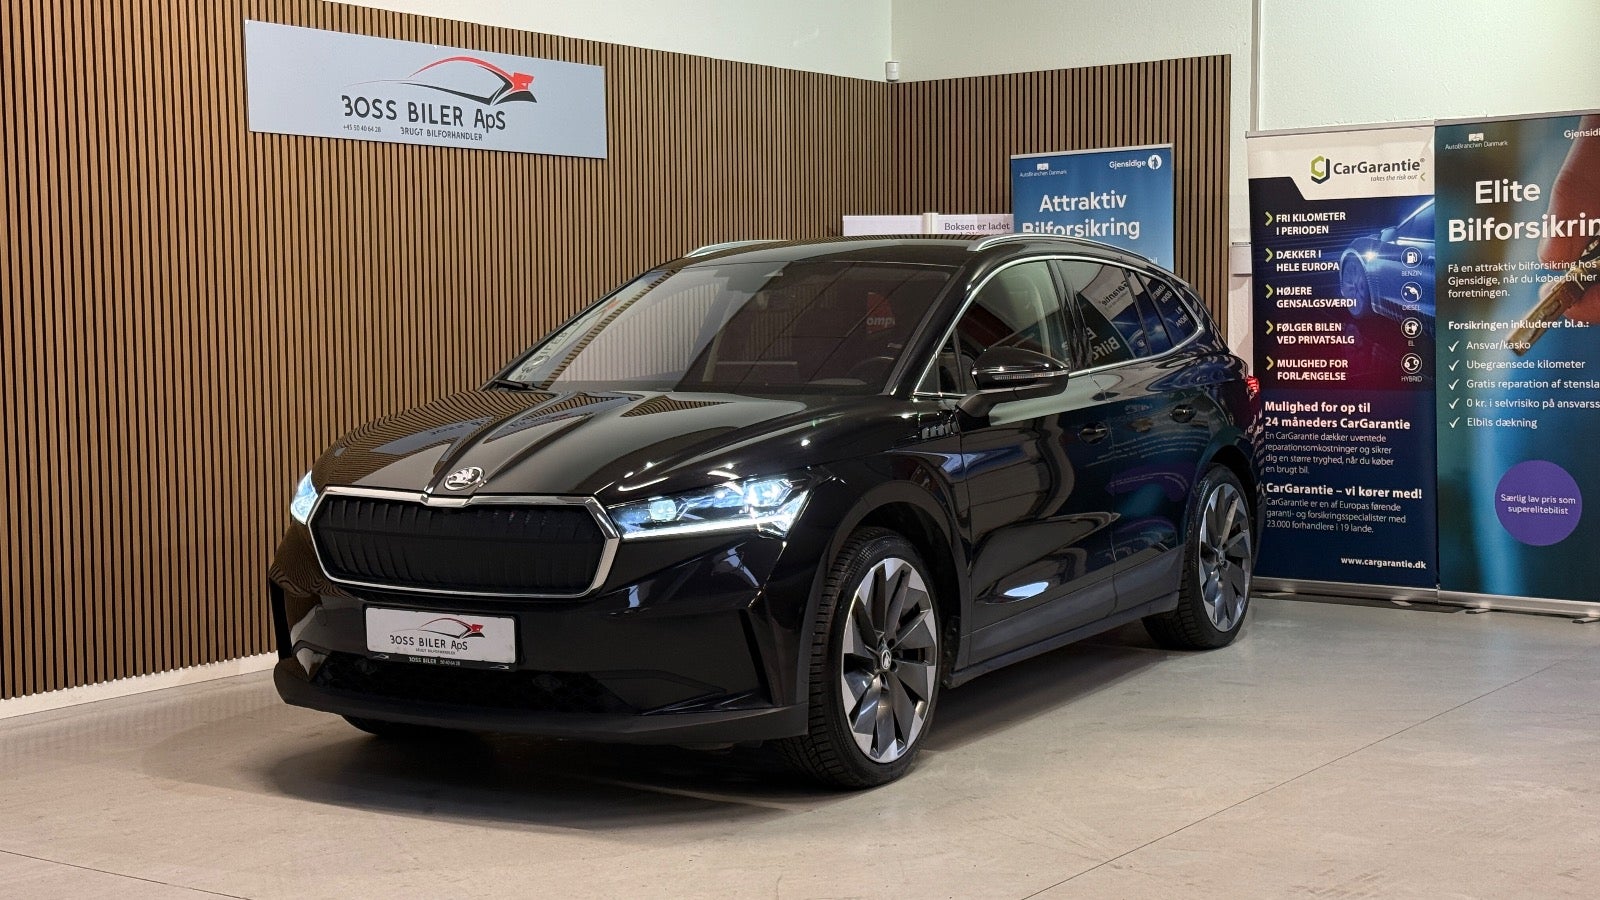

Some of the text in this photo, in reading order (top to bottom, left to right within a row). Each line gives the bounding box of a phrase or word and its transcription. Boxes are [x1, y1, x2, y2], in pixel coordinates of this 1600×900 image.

[408, 102, 464, 127] BILER
[474, 108, 506, 133] ApS
[426, 129, 482, 141] BILFORHANDLER
[1444, 141, 1482, 150] AutoBranchen
[1109, 160, 1146, 170] Gjensidige
[1475, 178, 1541, 204] Elite
[1039, 190, 1127, 213] Attraktiv
[1276, 212, 1346, 223] FRI KILOMETER
[944, 222, 975, 230] Boksen
[1022, 218, 1140, 240] Bilforsikring
[1276, 225, 1329, 235] I PERIODEN
[1276, 250, 1321, 260] DÆKKER I
[1276, 261, 1340, 272] HELE EUROPA
[1448, 264, 1459, 273] Få
[1475, 262, 1516, 272] attraktiv
[1518, 260, 1576, 271] bilforsikring
[1578, 260, 1597, 269] hos
[1448, 272, 1597, 288] Gjensidige, når du køber bil her
[1276, 286, 1312, 296] HØJERE
[1448, 288, 1511, 300] forretningen.
[1276, 298, 1357, 308] GENSALGSVÆRDI
[1276, 322, 1342, 333] FØLGER BILEN
[1448, 319, 1589, 331] Forsikringen inkluderer bl.a.:
[1277, 335, 1355, 345] VED PRIVATSALG
[1466, 341, 1531, 350] Ansvar/kasko
[1277, 359, 1348, 368] MULIGHED FOR
[1466, 360, 1585, 371] Ubegrænsede kilometer
[1277, 372, 1346, 381] FORLÆNGELSE
[1466, 379, 1600, 390] Gratis reparation af stensla
[1265, 401, 1370, 415] Mulighed for op til
[1466, 399, 1473, 408] 0
[1475, 399, 1486, 408] kr.
[1489, 399, 1492, 408] i
[1494, 398, 1540, 408] selvrisiko
[1542, 398, 1555, 410] på
[1265, 416, 1411, 429] 24 måneders CarGarantie
[1467, 418, 1538, 430] Elbils dækning
[1276, 432, 1319, 440] CarGarantie
[1320, 433, 1348, 441] dækker
[1350, 434, 1386, 442] uventede
[1265, 444, 1392, 455] reparationsomkostninger og sikrer
[1265, 454, 1277, 463] dig
[1313, 456, 1344, 465] tryghed,
[1346, 456, 1358, 464] når
[1360, 457, 1370, 465] du
[1372, 457, 1394, 466] køber
[1276, 465, 1298, 475] brugt
[1266, 483, 1333, 495] CarGarantie
[1345, 486, 1356, 496] vi
[1358, 487, 1390, 498] kører
[1392, 488, 1422, 499] med!
[1501, 494, 1526, 504] Særlig
[1541, 495, 1556, 504] pris
[1266, 498, 1309, 508] CarGarantie
[1339, 501, 1370, 511] Europas
[1371, 502, 1401, 512] førende
[1508, 506, 1568, 514] superelitebilist
[1266, 509, 1406, 523] garanti- og forsikringsspecialister med
[1266, 520, 1290, 528] 23.000
[1292, 521, 1334, 531] forhandlere
[1350, 524, 1374, 534] lande.
[1340, 557, 1426, 569] www.cargarantie.dk
[419, 638, 446, 648] BILER
[451, 640, 468, 652] ApS
